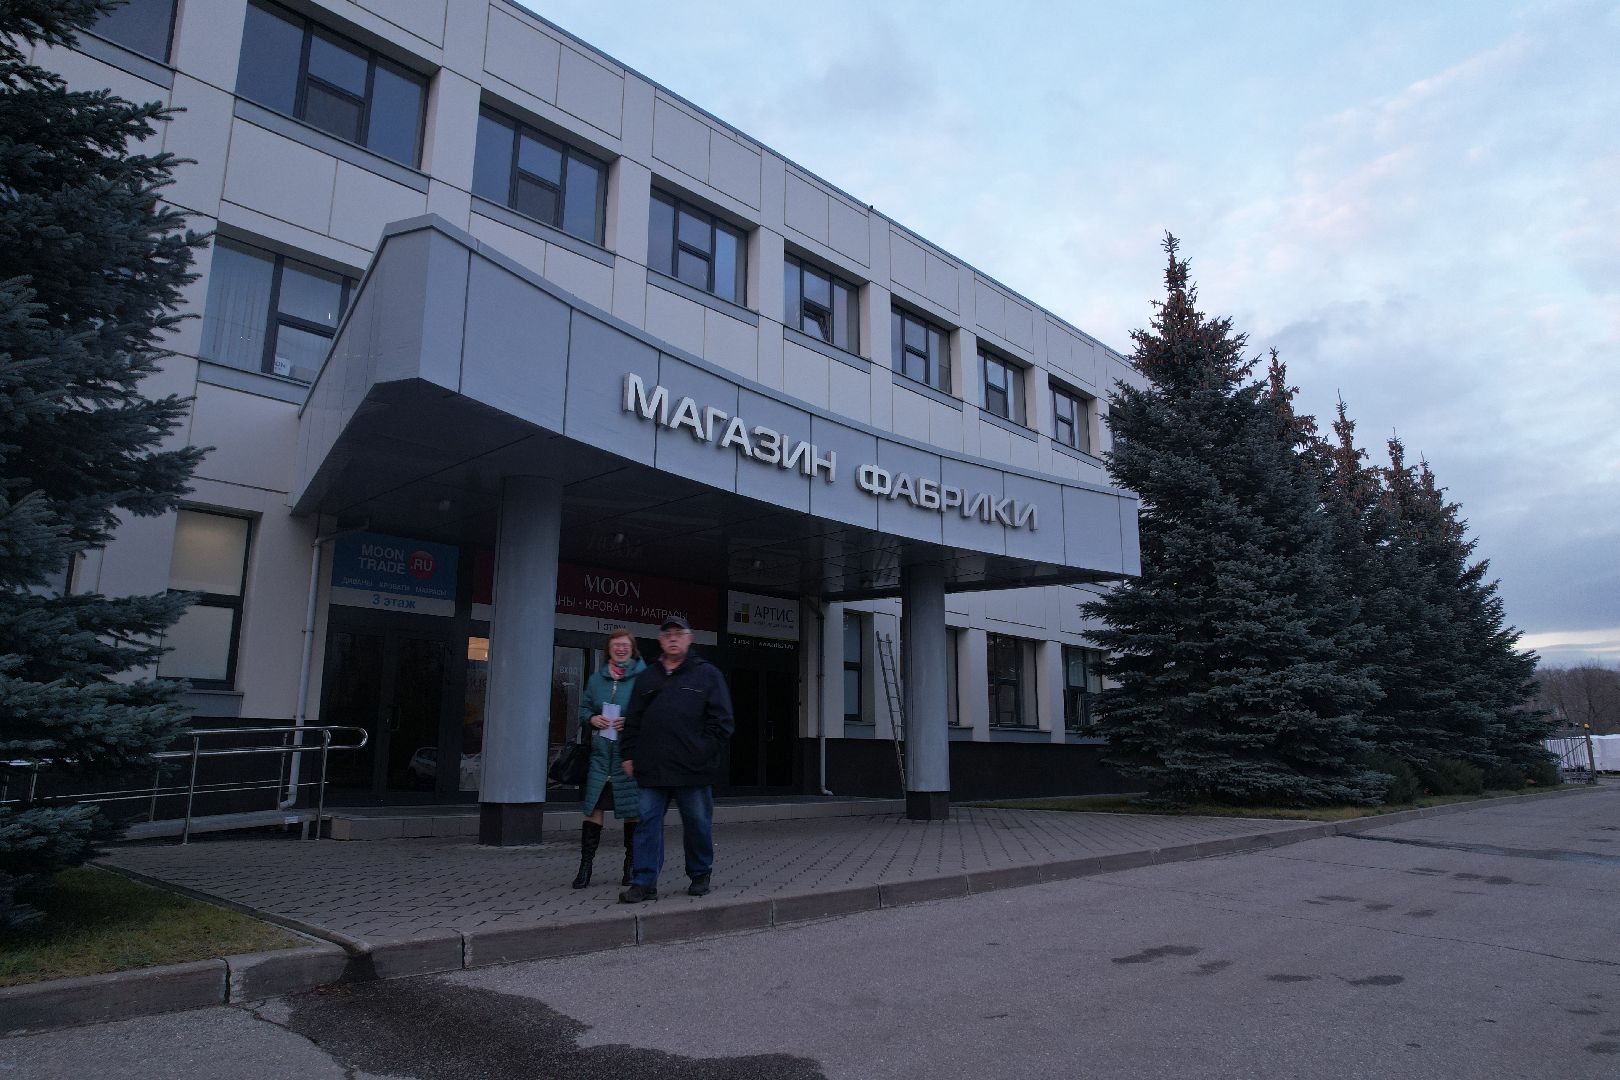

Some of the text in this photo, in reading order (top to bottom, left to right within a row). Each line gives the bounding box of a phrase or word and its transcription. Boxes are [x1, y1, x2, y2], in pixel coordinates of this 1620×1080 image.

[622, 371, 1039, 532] МАГАЗИН ФАБРИКИ
[361, 544, 405, 562] MOON
[358, 557, 406, 575] TRADE
[342, 576, 448, 596] ДИВАНЫ КРОВАТИ МАТРАСЫ
[584, 574, 641, 600] MOON
[372, 593, 416, 609] 3 этаж
[585, 599, 633, 615] КРОВАТИ
[753, 605, 794, 623] АРТИС
